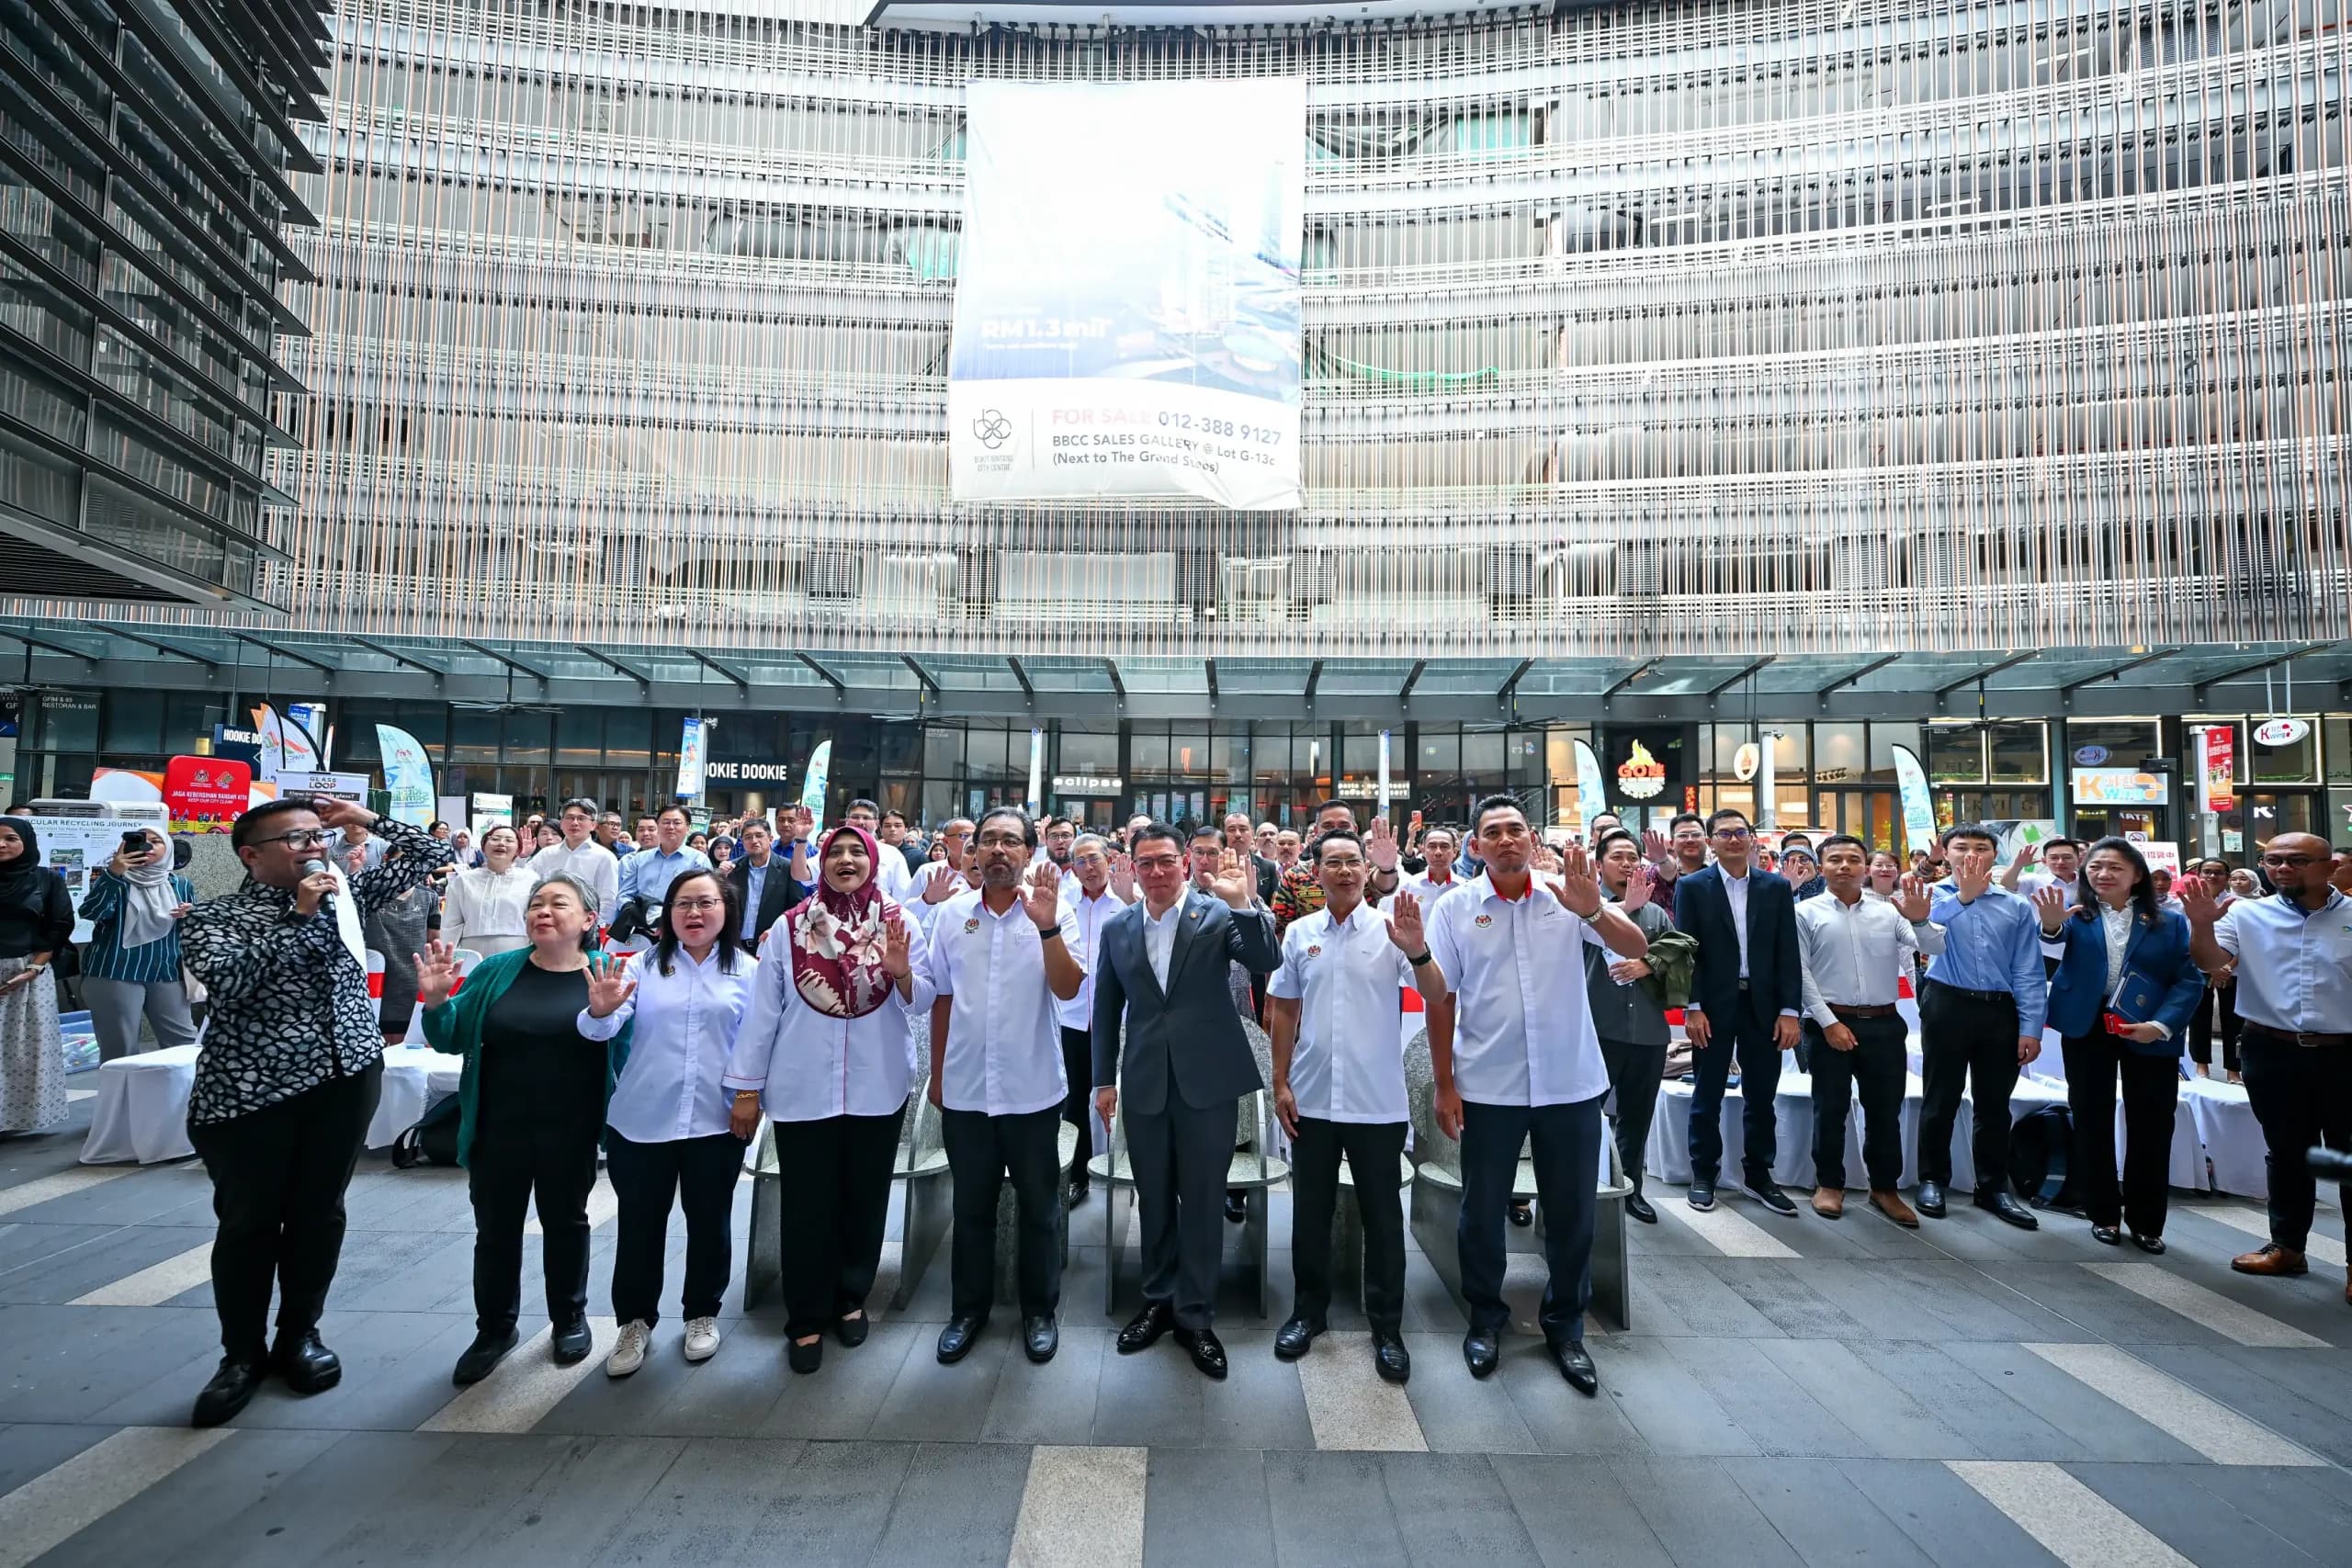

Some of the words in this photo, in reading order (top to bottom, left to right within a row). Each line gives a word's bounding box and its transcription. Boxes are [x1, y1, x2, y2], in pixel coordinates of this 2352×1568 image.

[1053, 410, 1093, 424] FOR
[1159, 412, 1234, 436] 012-388
[1240, 424, 1282, 446] 9127
[1053, 434, 1089, 446] BBCC
[1093, 434, 1135, 446] SALES
[1139, 434, 1199, 451] GALLERY
[1217, 446, 1237, 459] Lot
[1053, 453, 1089, 467] (Next
[1093, 453, 1107, 463] to
[1111, 451, 1135, 463] The
[223, 728, 251, 743] HOOKIE
[741, 764, 787, 781] DOOKIE
[2079, 775, 2104, 798] K
